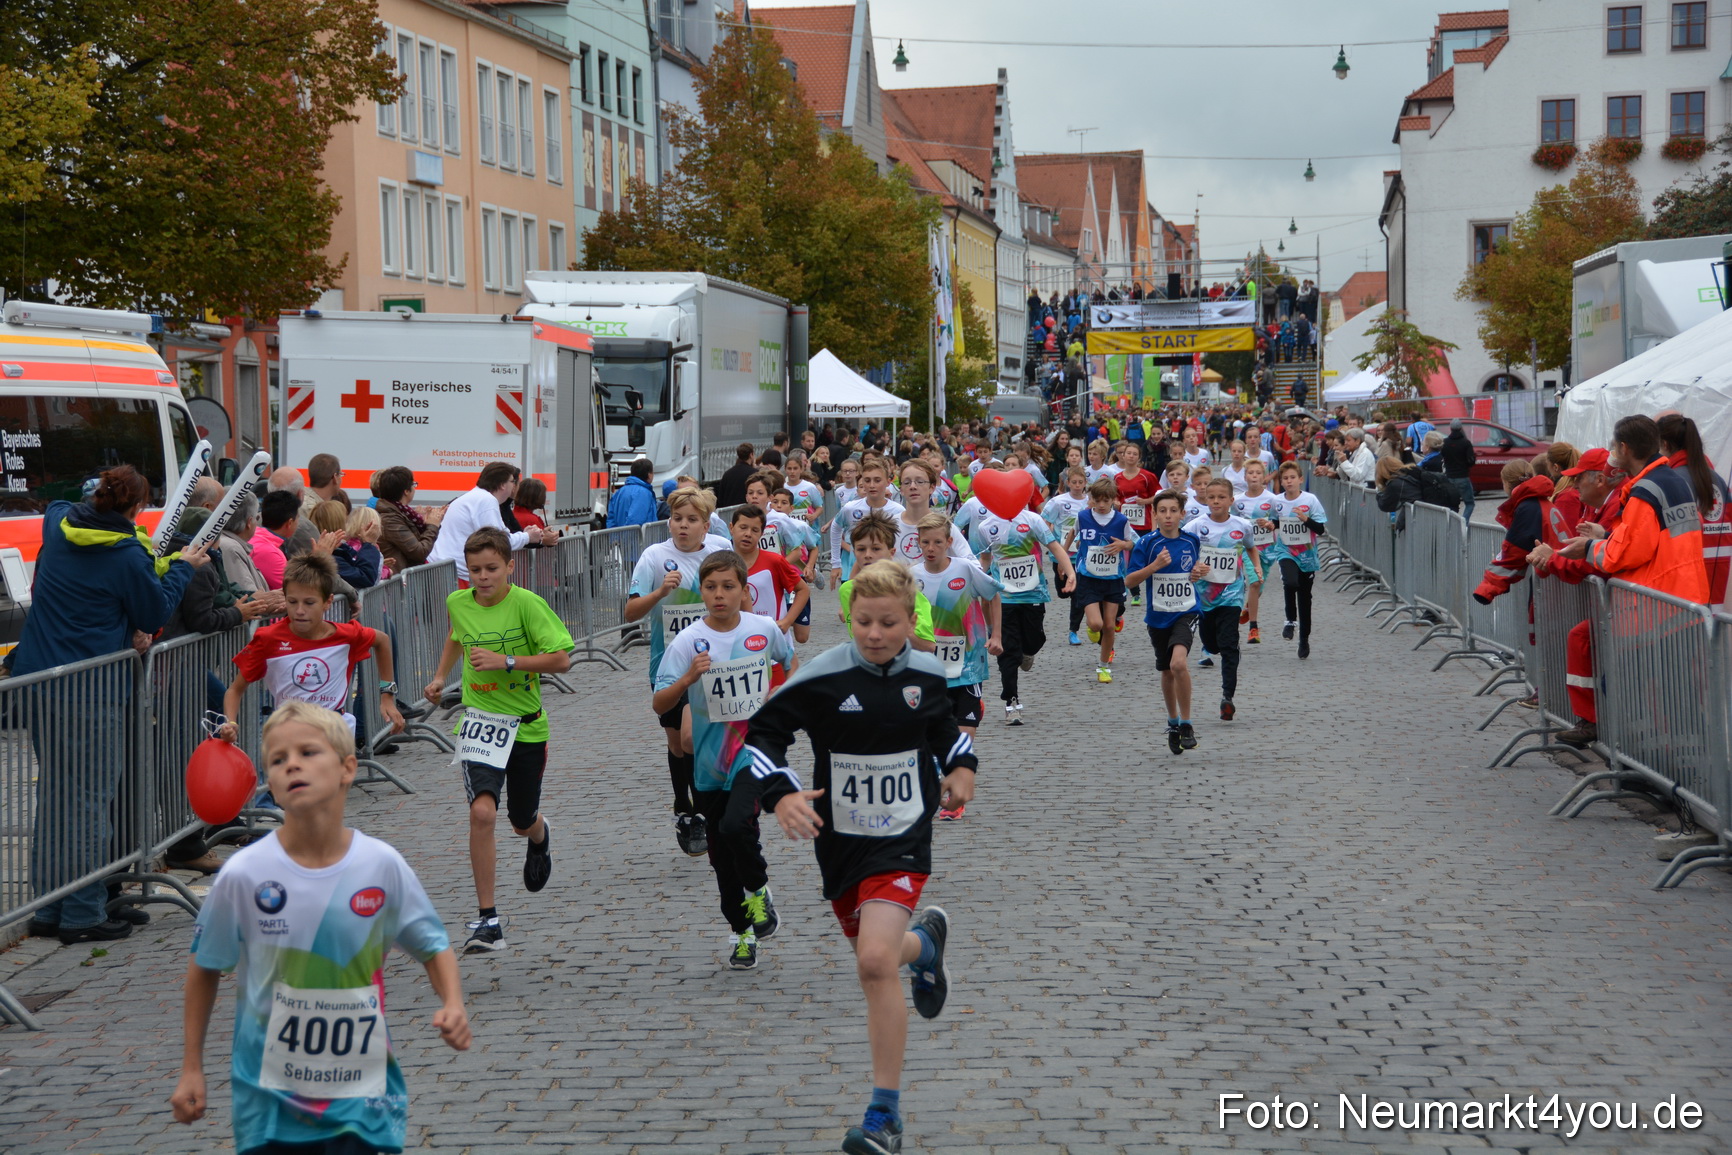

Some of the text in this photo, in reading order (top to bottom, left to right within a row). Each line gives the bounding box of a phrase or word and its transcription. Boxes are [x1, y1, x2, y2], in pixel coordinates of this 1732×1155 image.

[556, 321, 628, 337] OCK
[1141, 334, 1198, 349] START
[491, 367, 518, 375] 44/54/1
[759, 341, 781, 390] BOCK
[392, 380, 472, 394] Bayerisches
[392, 397, 429, 408] Rotes
[814, 403, 866, 415] Laufsport
[391, 413, 429, 425] Kreuz
[1, 429, 42, 450] Bayerisches
[5, 451, 25, 470] Rotes
[432, 449, 516, 459] Katastrophenschutz
[439, 459, 476, 467] Freistaat
[7, 474, 28, 493] Kreuz
[183, 468, 203, 500] BMW
[229, 481, 254, 511] BMW
[1123, 508, 1143, 518] 4013
[1080, 528, 1097, 541] 13
[1282, 524, 1308, 535] 4000
[1090, 554, 1117, 565] 4025
[1203, 555, 1235, 571] 4102
[1003, 564, 1034, 580] 4027
[1157, 582, 1192, 598] 4006
[663, 608, 682, 616] PARTL
[702, 661, 758, 676] PARTL Neumarkt
[711, 669, 763, 699] 4117
[720, 697, 763, 716] LUKAS
[478, 713, 509, 726] Neumarkt
[459, 719, 510, 749] 4039
[461, 745, 491, 758] Hannes
[833, 761, 905, 772] PARTL Neumarkt
[841, 772, 912, 805] 4100
[849, 809, 893, 829] FELIX
[258, 919, 289, 929] PARTL
[276, 992, 370, 1011] PARTL Neumarkt
[278, 1014, 377, 1056] 4007
[284, 1062, 362, 1083] Sebastian
